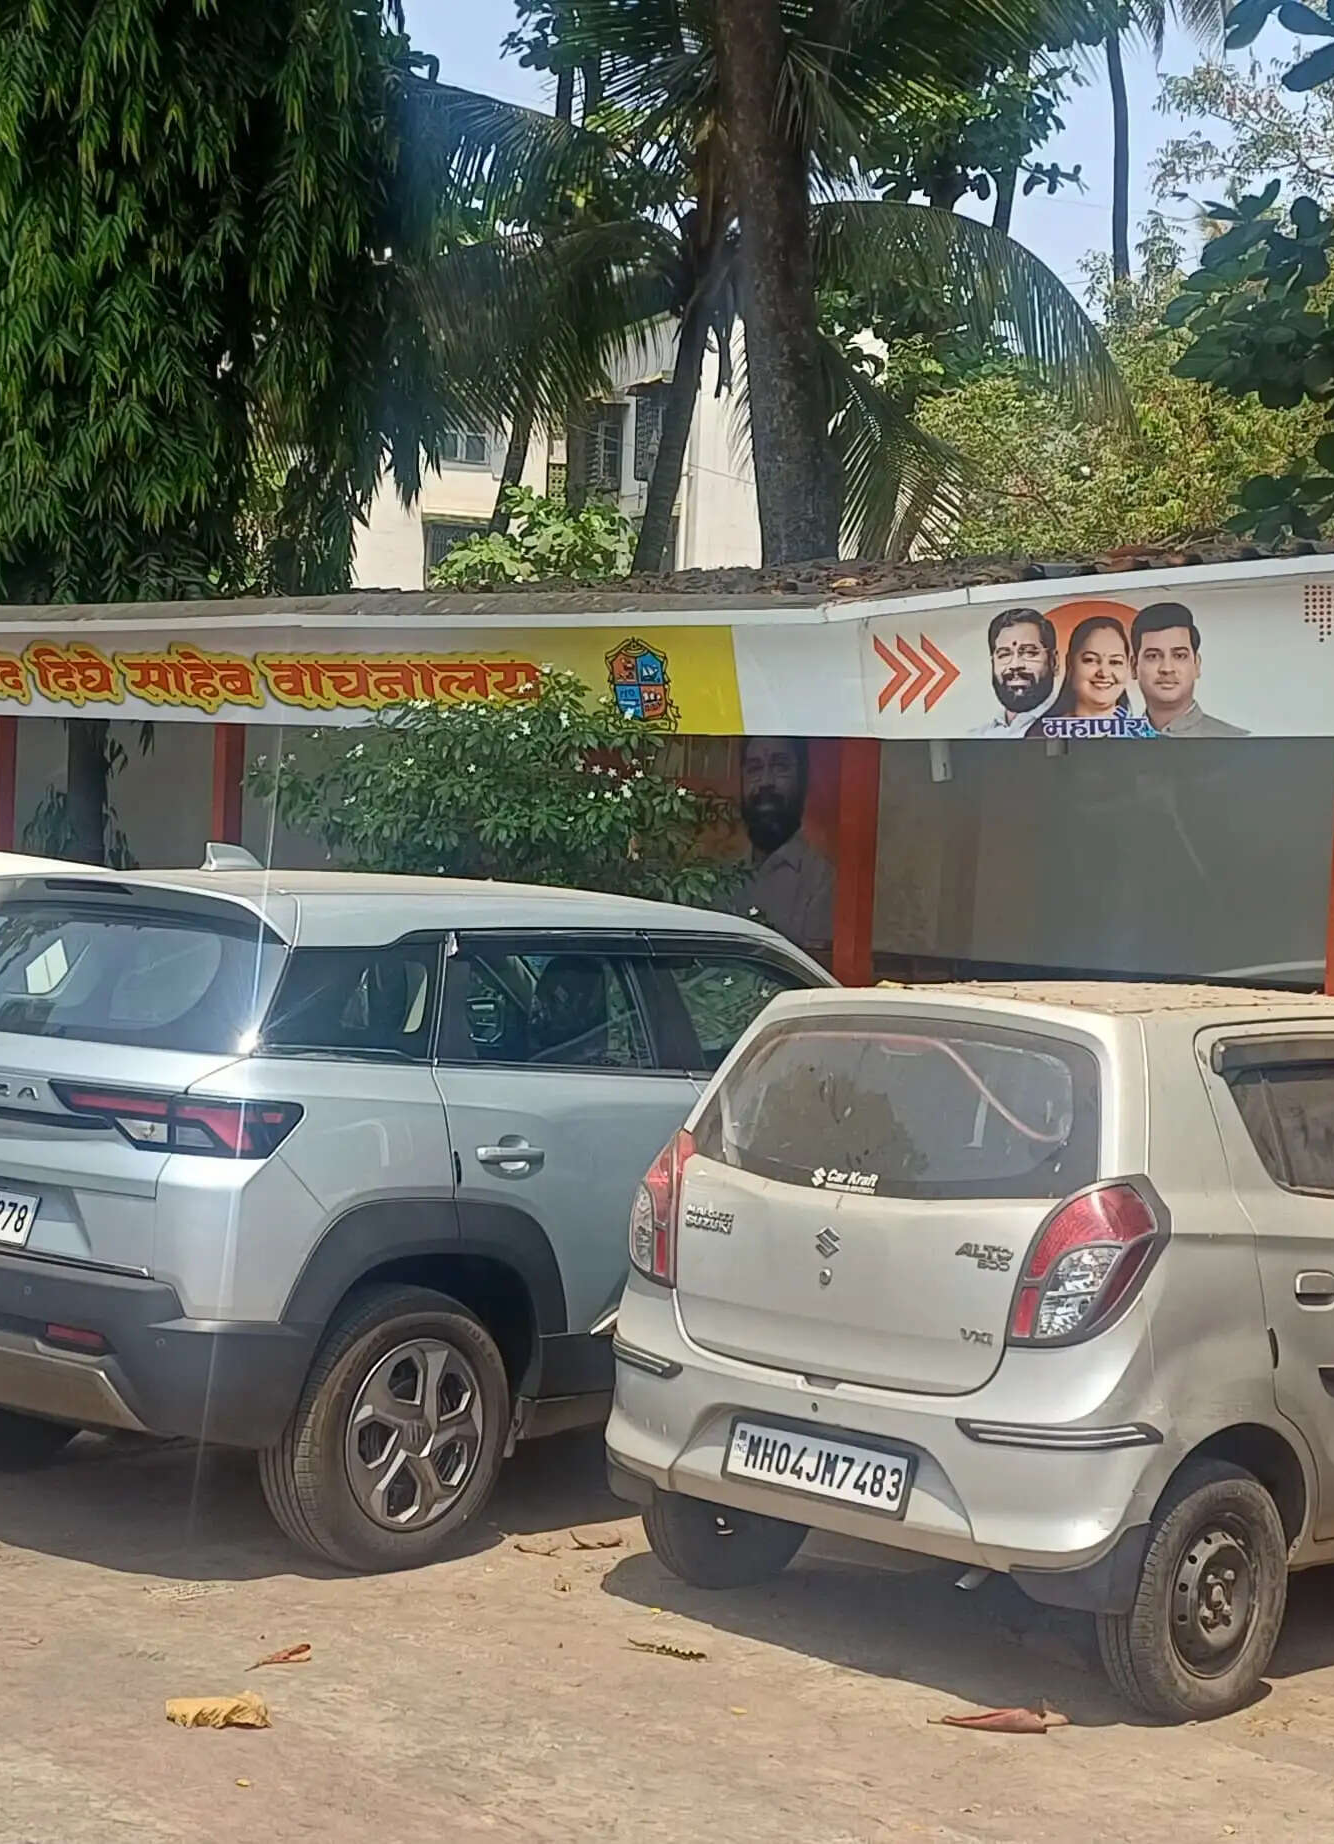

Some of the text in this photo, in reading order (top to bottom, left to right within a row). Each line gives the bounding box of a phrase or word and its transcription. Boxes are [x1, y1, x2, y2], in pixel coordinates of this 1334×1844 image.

[27, 642, 122, 704] दिघे
[116, 643, 263, 711] साहेब
[257, 654, 542, 706] वाचनालय
[1041, 704, 1151, 738] महापौर
[826, 1168, 879, 1188] Car Kraft
[685, 1214, 733, 1234] SUZUKI
[955, 1242, 1014, 1262] ALTO
[744, 1433, 904, 1502] MH04JM7483
